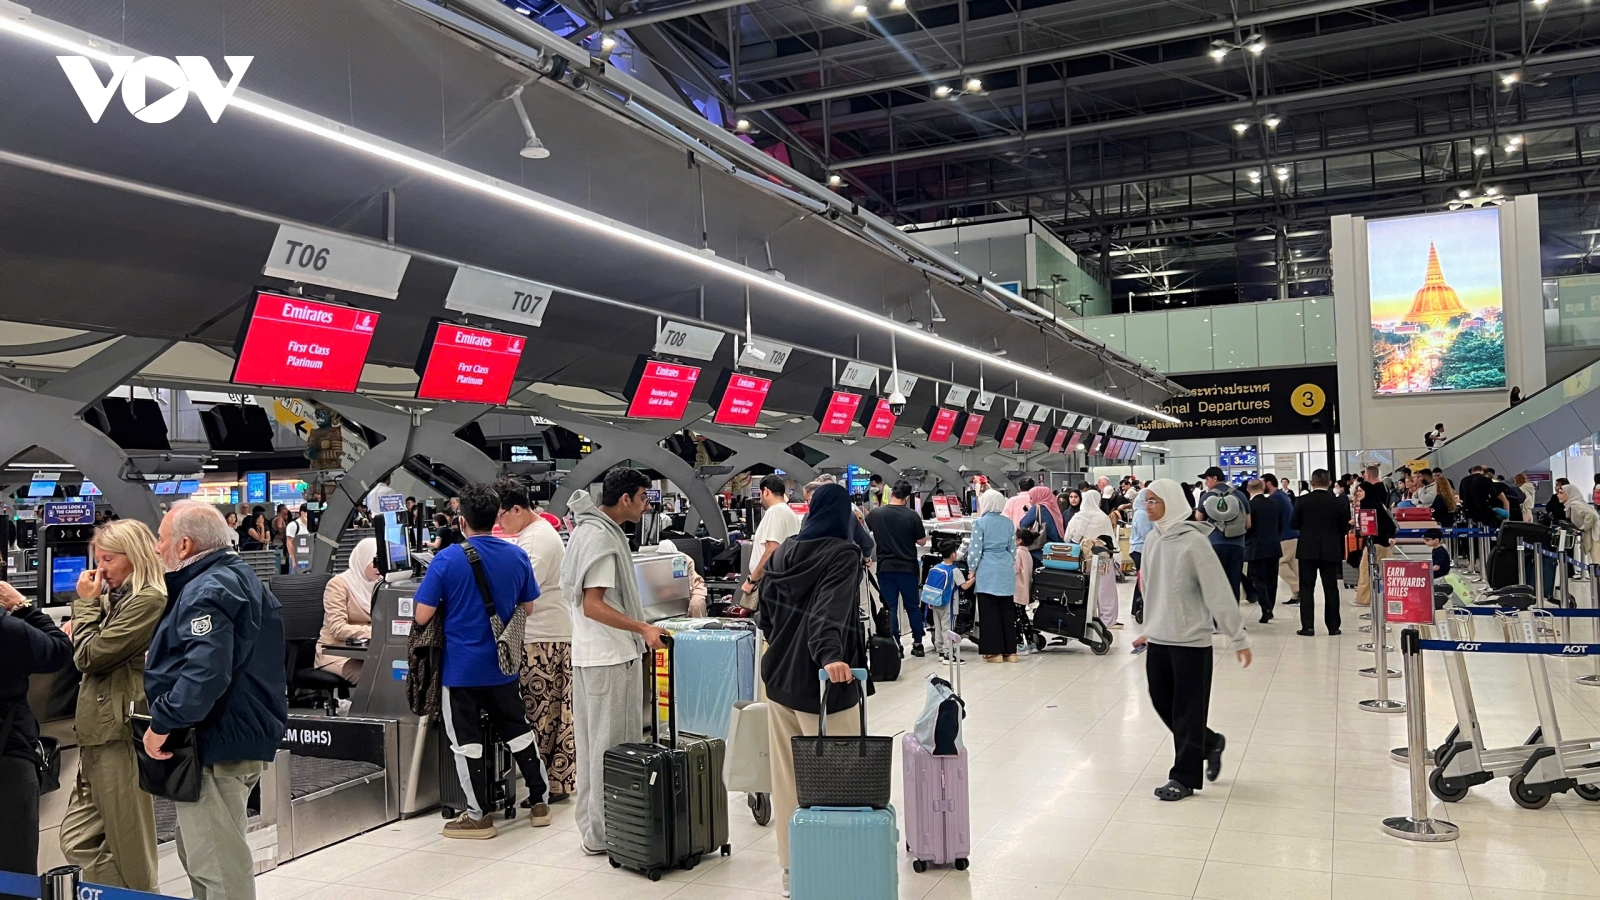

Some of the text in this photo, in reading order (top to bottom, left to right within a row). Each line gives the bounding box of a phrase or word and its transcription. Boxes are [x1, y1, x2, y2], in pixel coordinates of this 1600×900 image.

[285, 239, 330, 271] T06
[512, 291, 543, 314] T07
[282, 302, 333, 324] Emirates
[455, 331, 492, 347] Emirates
[665, 330, 687, 346] T08
[287, 340, 330, 356] First Class
[286, 355, 323, 369] Platinum
[770, 350, 786, 365] T09
[457, 362, 489, 374] First Class
[656, 366, 679, 377] Emirates
[456, 375, 484, 386] Platinum
[1185, 383, 1271, 397] ระหว่างประเทศ
[1301, 391, 1315, 408] 3
[1198, 399, 1271, 415] Departures
[1200, 415, 1273, 429] Passport Control
[1387, 567, 1405, 577] EARN
[1387, 577, 1426, 588] SKYWARDS
[1387, 587, 1409, 597] MILES
[1456, 642, 1481, 651] AOT
[1562, 645, 1588, 654] AOT
[300, 730, 332, 746] (BHS)
